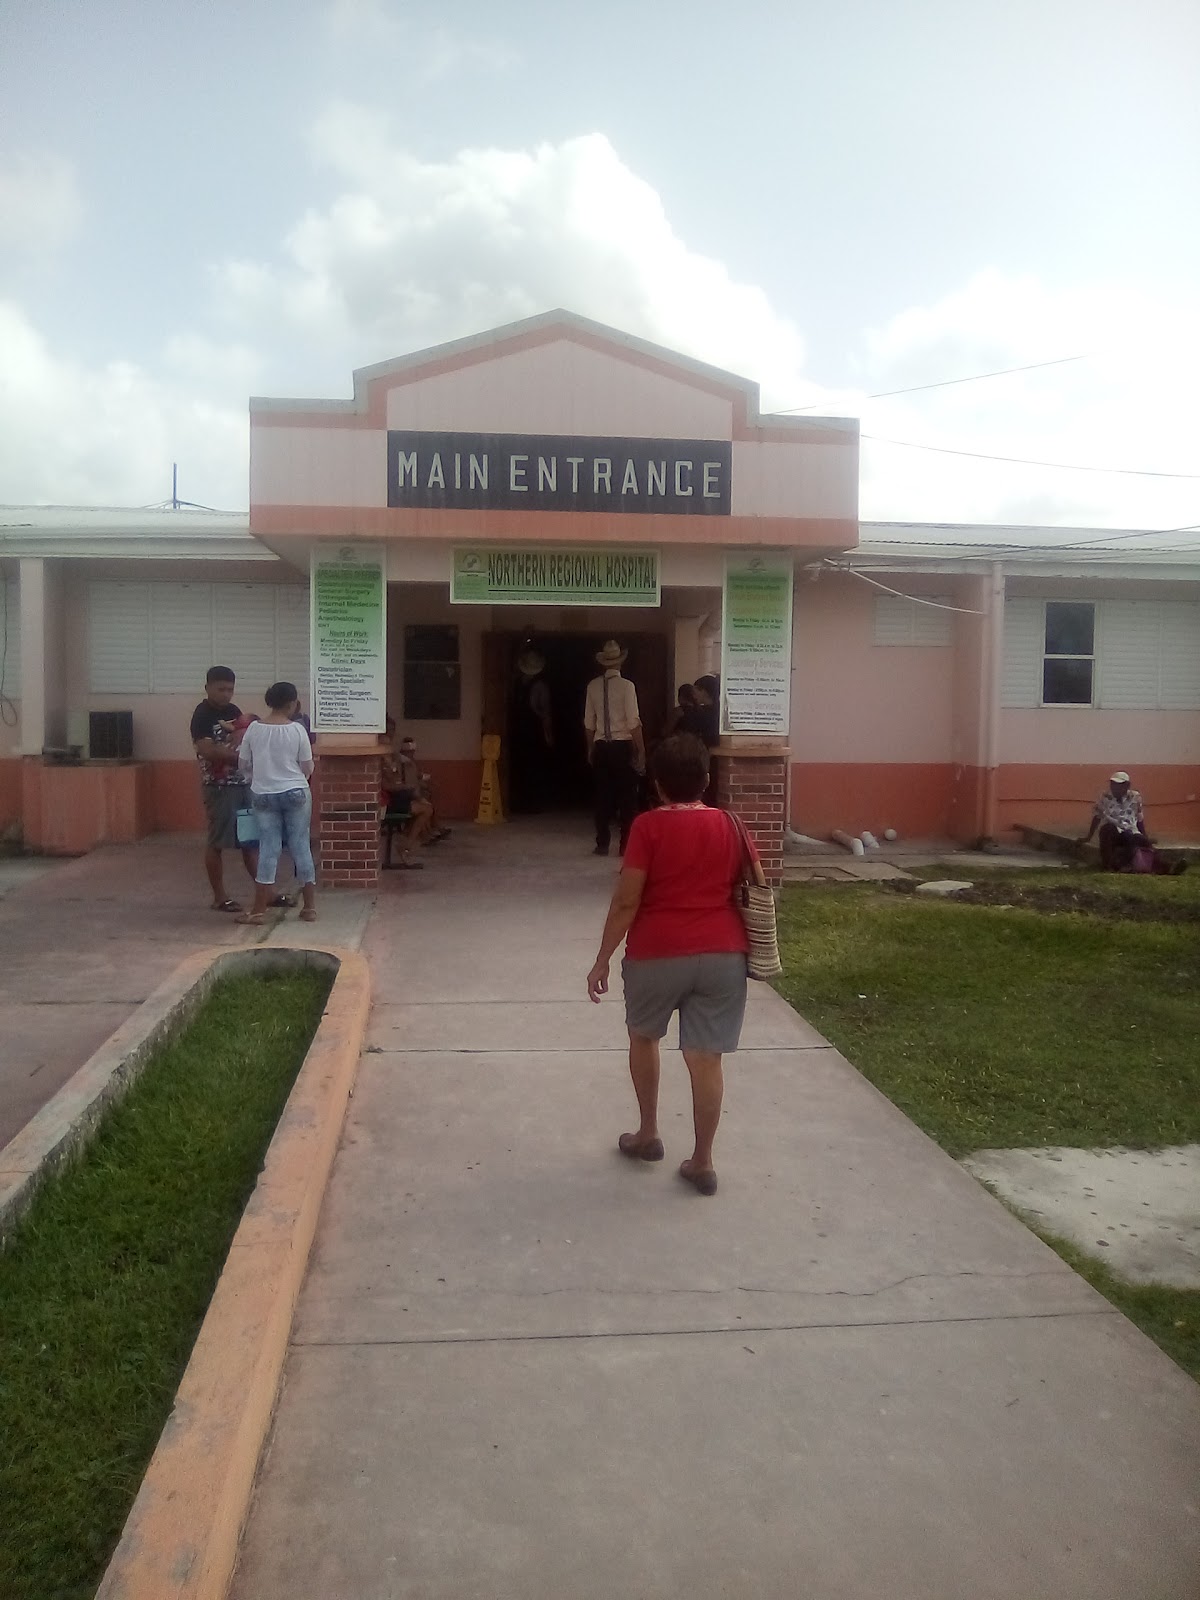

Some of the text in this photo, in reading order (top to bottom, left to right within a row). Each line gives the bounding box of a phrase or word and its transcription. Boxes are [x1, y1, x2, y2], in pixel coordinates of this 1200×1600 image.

[398, 451, 722, 498] MAIN ENTRANCE
[488, 553, 656, 589] NORTHERN REGIONAL HOSPITAL
